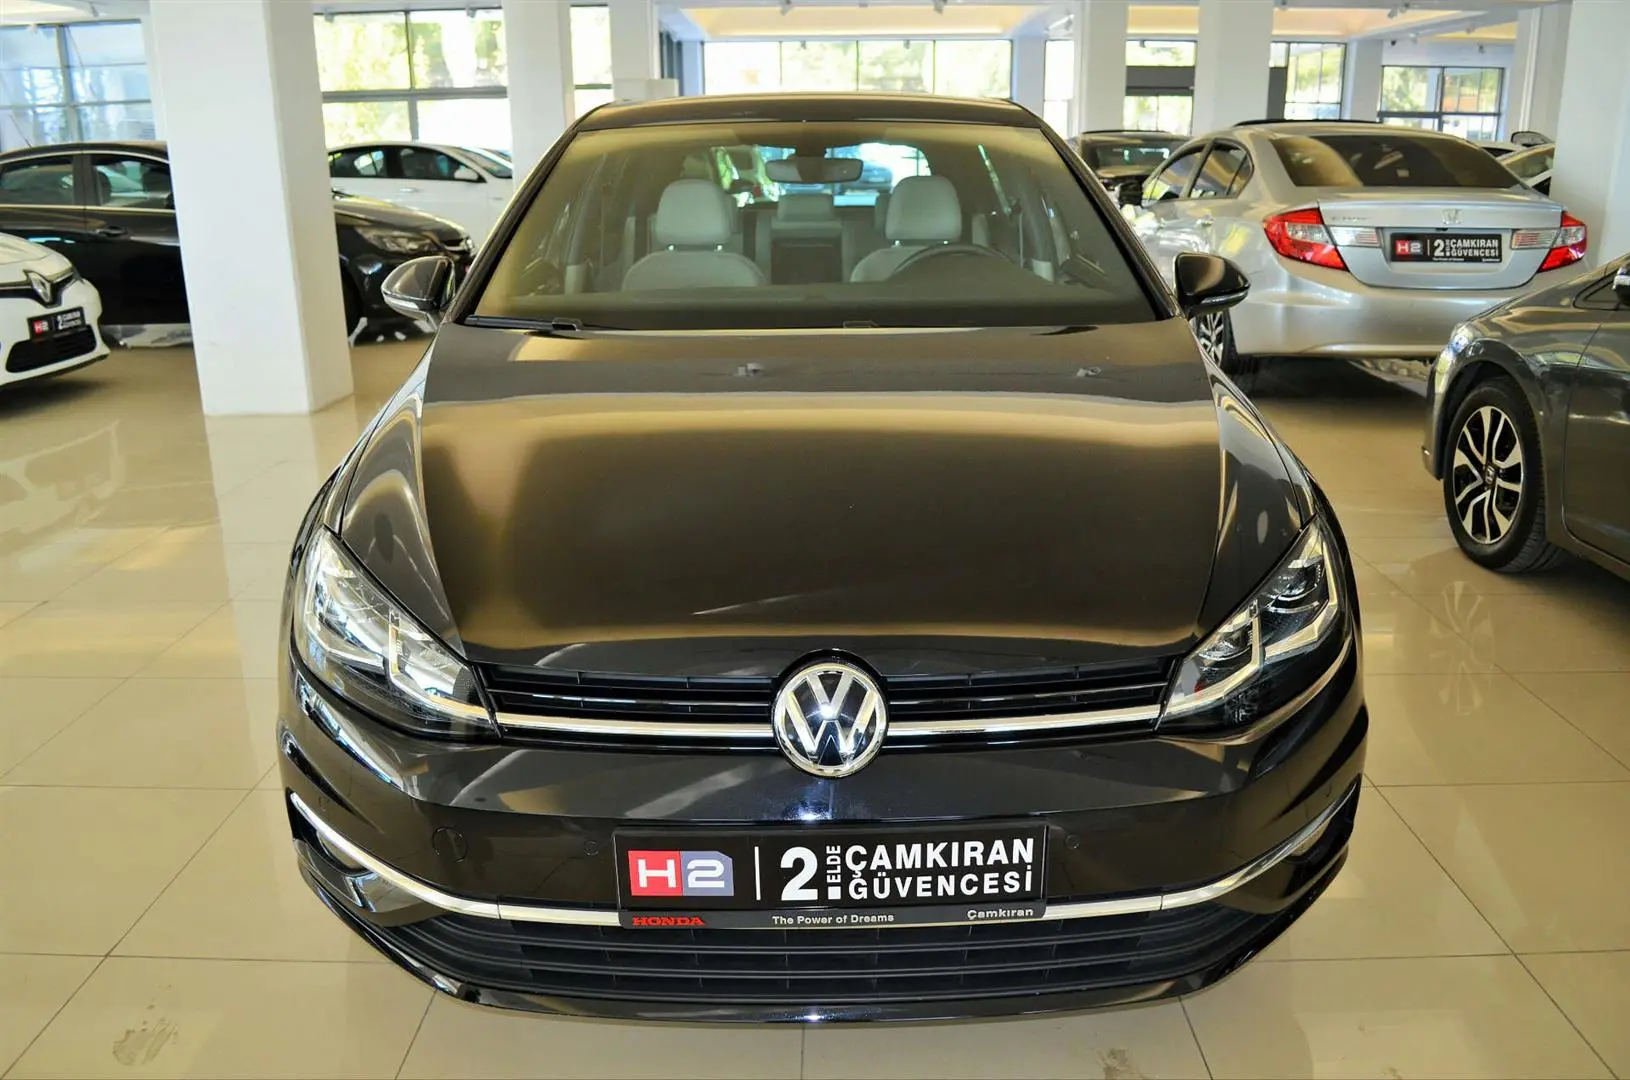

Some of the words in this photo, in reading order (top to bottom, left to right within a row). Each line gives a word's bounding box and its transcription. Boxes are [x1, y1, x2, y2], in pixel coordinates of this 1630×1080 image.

[1450, 239, 1499, 250] ÇAMKIRAN
[826, 845, 841, 883] ELDE
[845, 838, 1034, 879] ÇAMKIRAN
[637, 858, 725, 889] H2
[848, 865, 1032, 900] GÜVENCESİ
[631, 916, 706, 926] HONDA
[772, 915, 794, 925] The
[797, 915, 833, 925] Power
[836, 914, 848, 924] of
[850, 913, 895, 923] Dreams
[966, 908, 1034, 920] Çamkıran
